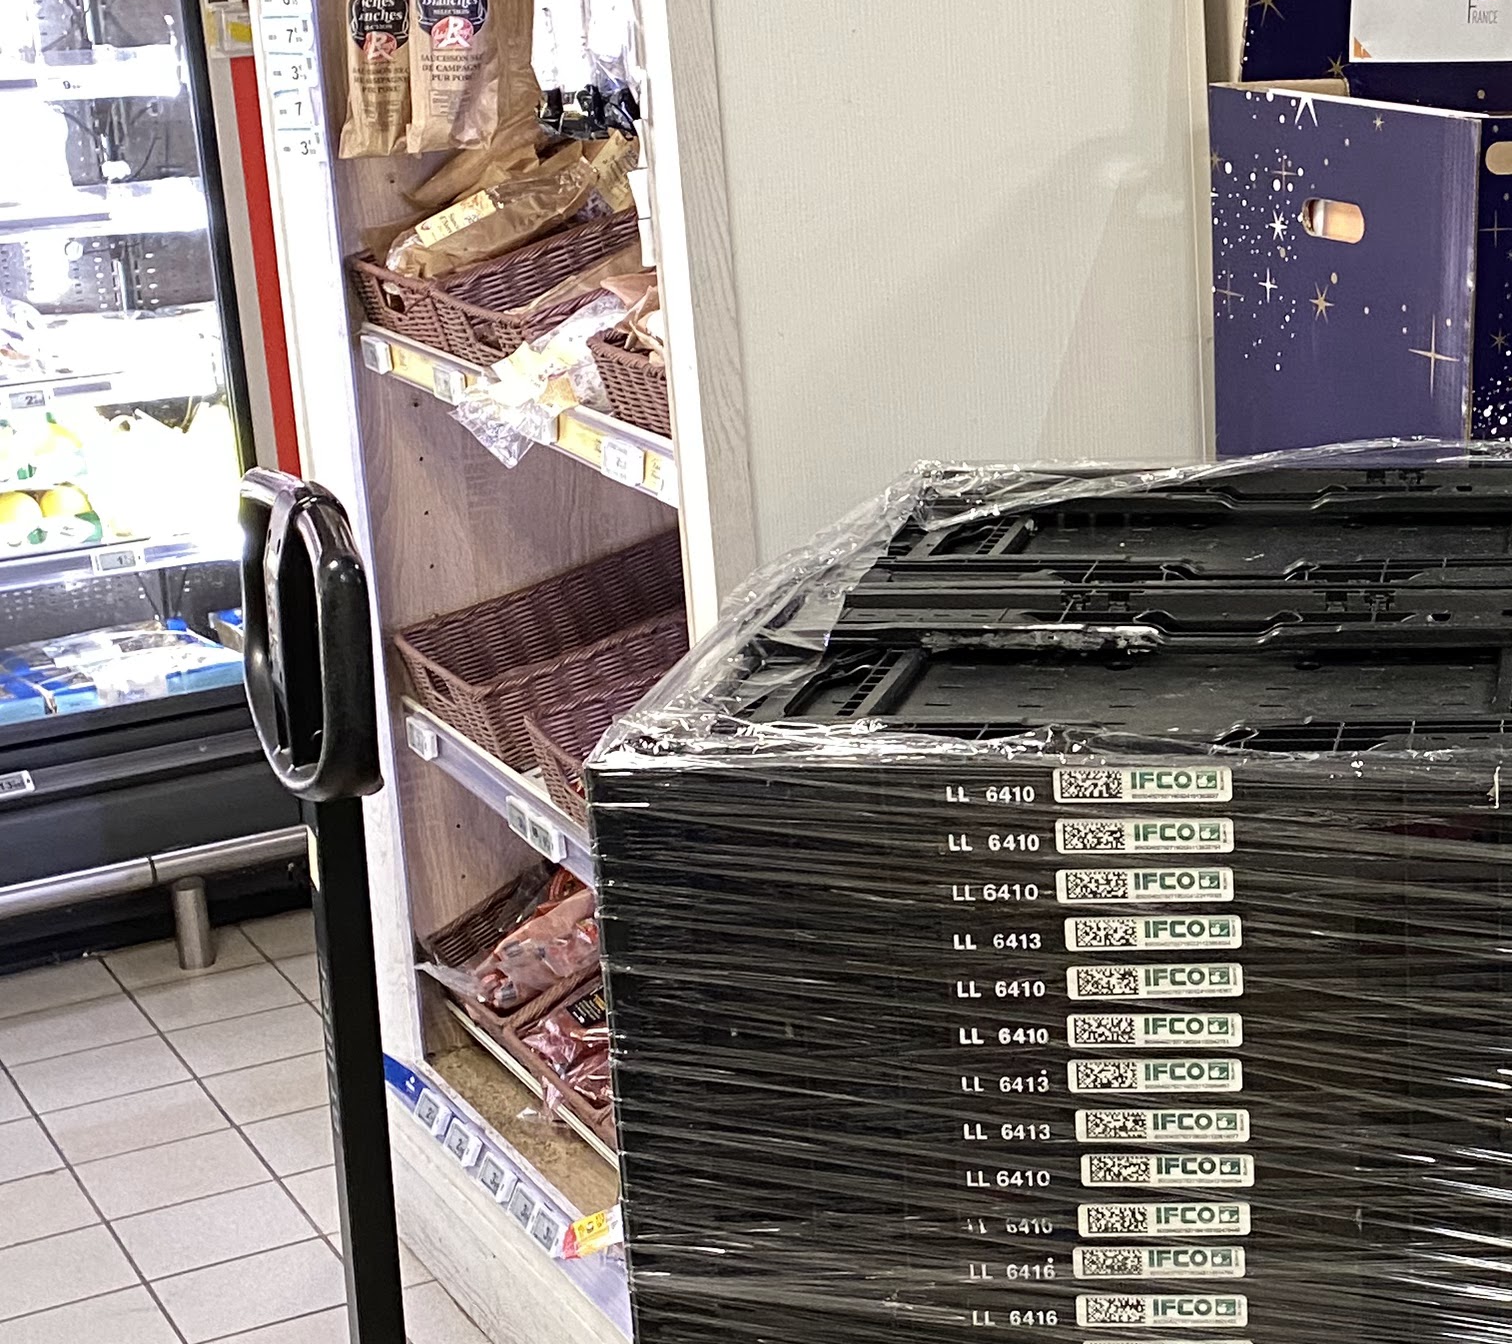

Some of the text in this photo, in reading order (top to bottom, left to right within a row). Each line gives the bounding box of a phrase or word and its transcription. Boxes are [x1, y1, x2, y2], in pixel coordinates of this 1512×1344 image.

[946, 771, 1192, 803] LL 6410 IFCO
[948, 823, 1195, 851] LL 6410 IFCO
[953, 920, 1205, 950] LL 6413 IFCO
[957, 968, 1205, 998] LL 6410 IFCO
[964, 1113, 1212, 1140] LL 6413 IFCO
[966, 1157, 1216, 1187] LL 6410 IFCO
